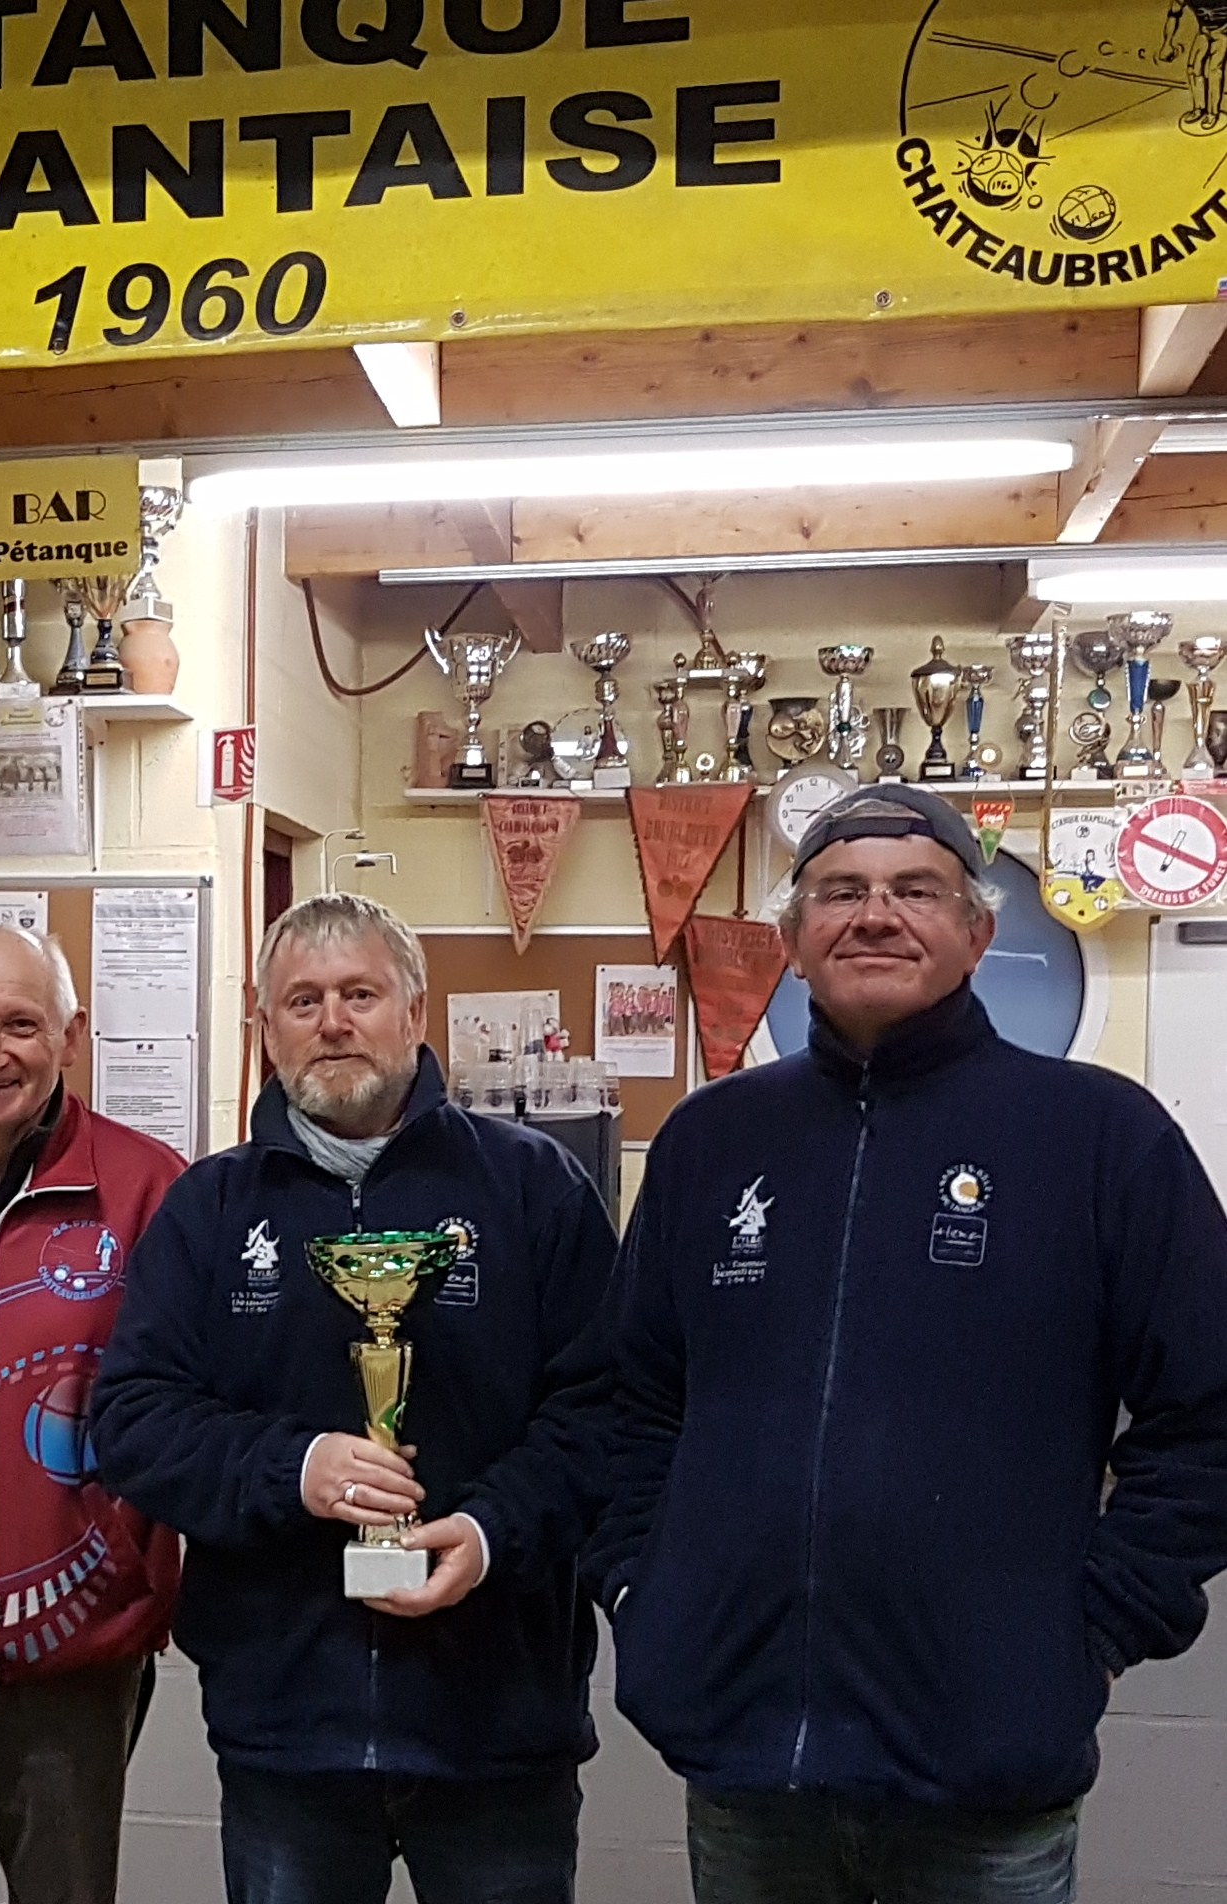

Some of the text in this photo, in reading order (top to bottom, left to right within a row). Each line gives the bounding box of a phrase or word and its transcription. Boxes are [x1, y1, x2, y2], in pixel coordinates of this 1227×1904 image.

[896, 137, 1227, 288] CHATEAUBRIANT
[34, 251, 327, 355] 1960
[13, 490, 107, 525] BAR
